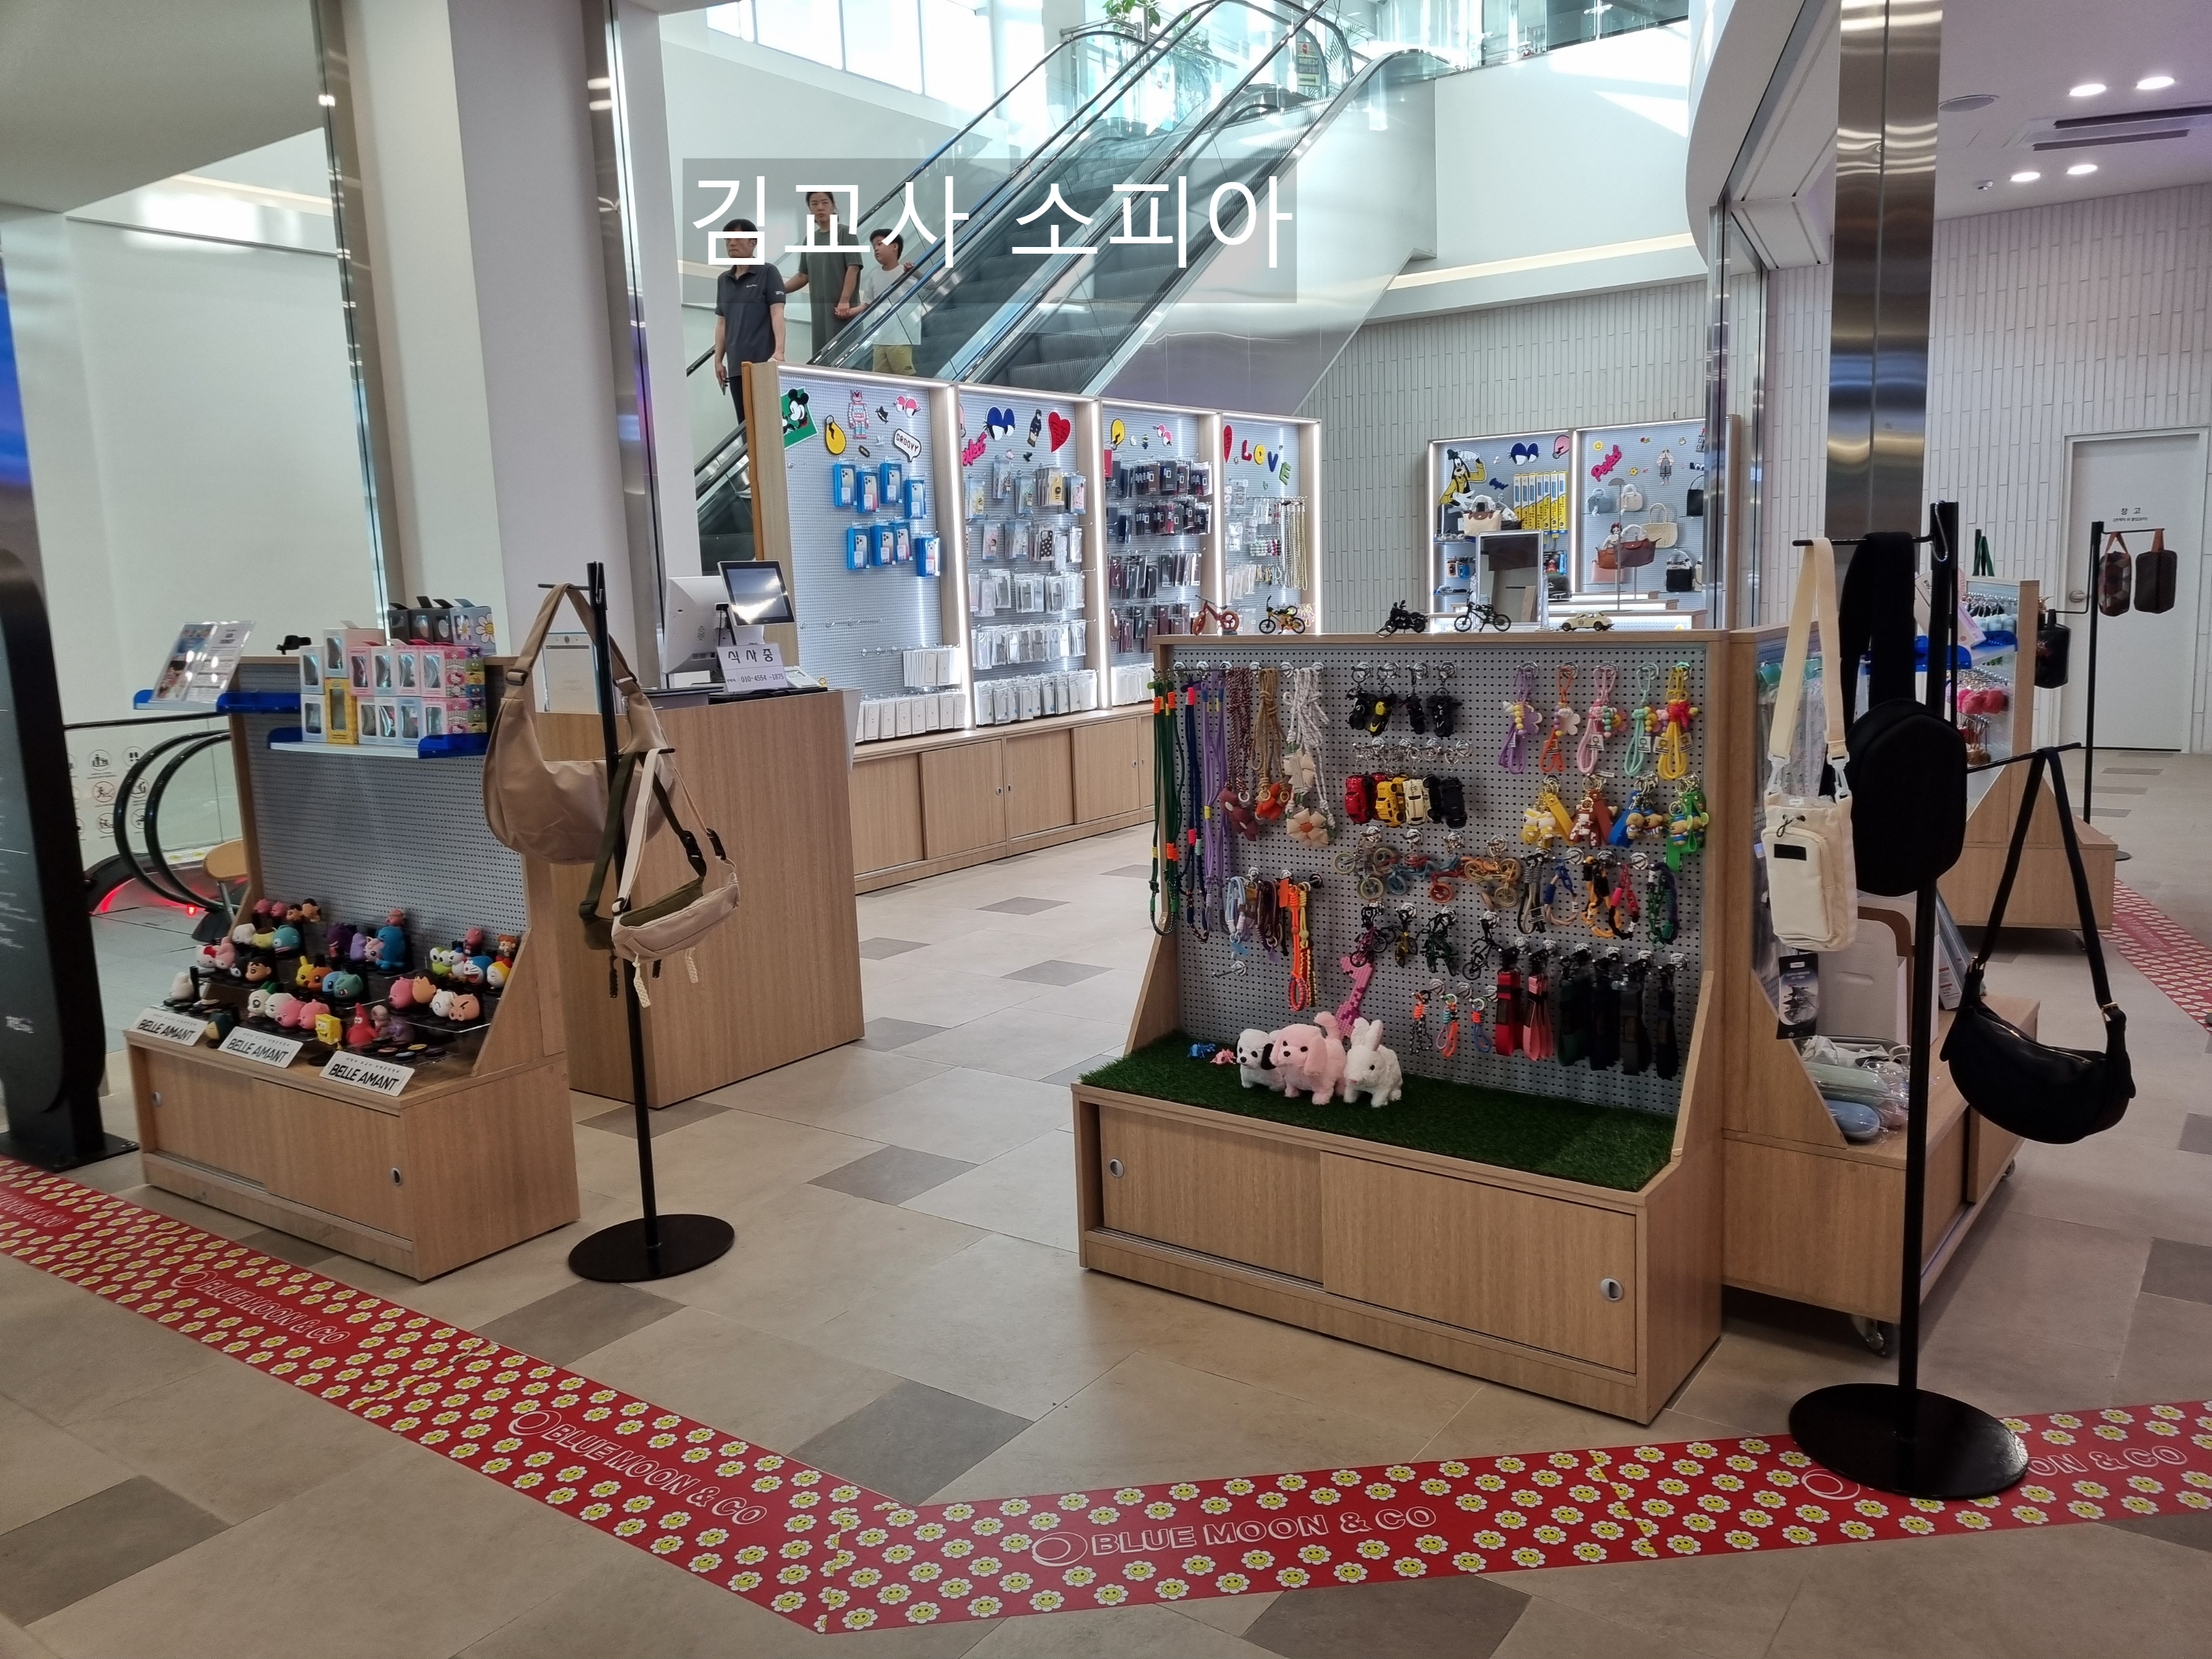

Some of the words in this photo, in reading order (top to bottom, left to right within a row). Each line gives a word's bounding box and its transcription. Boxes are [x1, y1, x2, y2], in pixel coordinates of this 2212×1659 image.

[896, 433, 919, 453] GROOVY
[961, 431, 987, 466] erfect
[1242, 439, 1292, 486] LOVE
[137, 1019, 164, 1034] BELLE
[160, 1025, 197, 1041] AMANT
[226, 1038, 254, 1054] BELLE
[251, 1045, 289, 1063] AMANT
[328, 1063, 361, 1082] BELLE
[357, 1071, 400, 1091] AMANT
[195, 1279, 255, 1304] BLUE
[235, 1295, 309, 1326] MOON
[289, 1318, 321, 1334] &
[305, 1326, 351, 1344] CO
[541, 1423, 622, 1461] BLUE
[603, 1449, 701, 1496] MOON
[686, 1486, 721, 1508] &
[712, 1497, 768, 1526] CO
[2028, 1453, 2089, 1476] ON
[2089, 1450, 2130, 1471] &
[2123, 1445, 2188, 1468] CO
[1091, 1526, 1197, 1556] BLUE
[1203, 1514, 1329, 1546] MOON
[1338, 1511, 1371, 1533] &
[1374, 1505, 1438, 1528] CO
